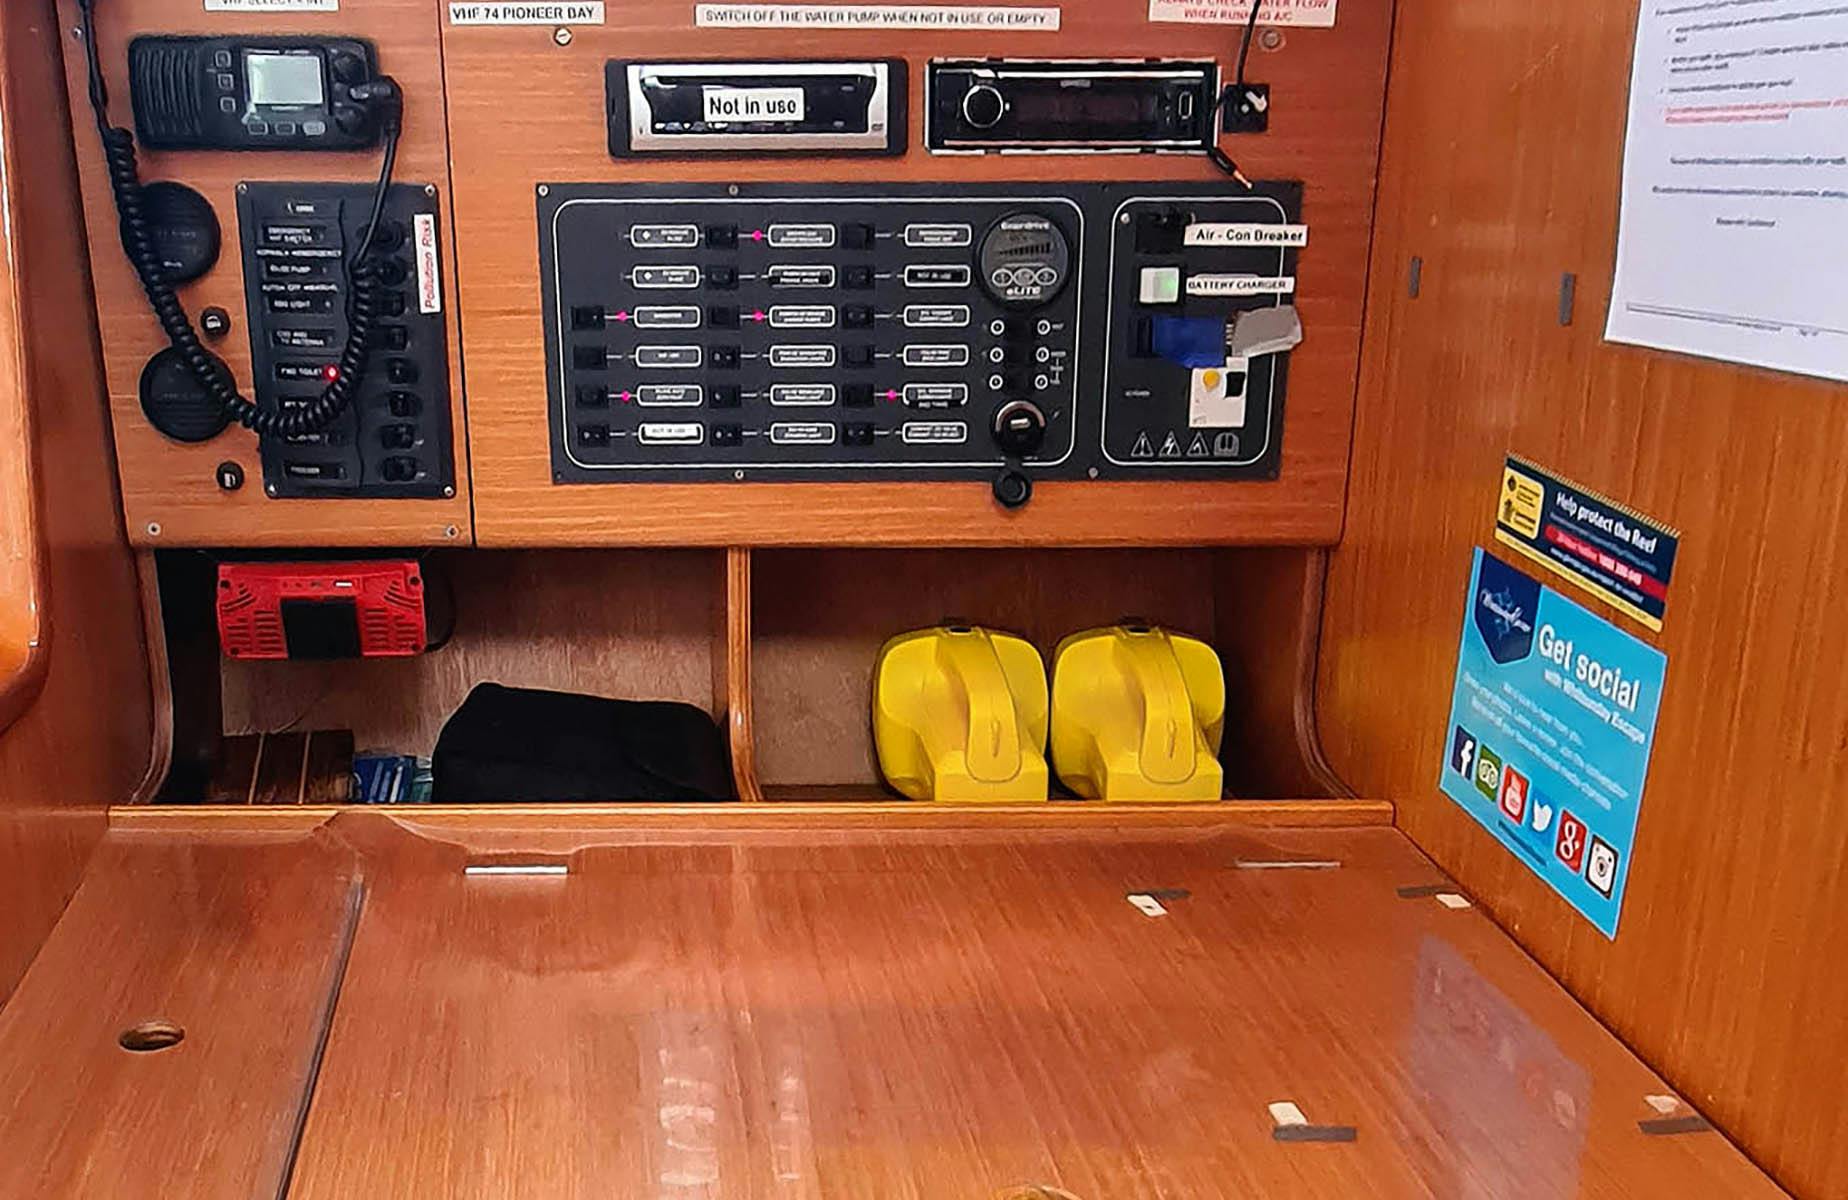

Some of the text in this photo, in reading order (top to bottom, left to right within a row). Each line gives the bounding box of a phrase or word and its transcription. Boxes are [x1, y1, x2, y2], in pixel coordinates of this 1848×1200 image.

[453, 6, 479, 19] VHF
[484, 6, 499, 19] 74
[503, 6, 564, 19] PIONEER
[706, 9, 1046, 24] SWITCH OFF THE WATER PUMP WHEN NOT IN USE OR EMPTY
[709, 95, 796, 115] Not in use
[1196, 228, 1215, 241] Air
[1226, 228, 1250, 241] Con
[1254, 229, 1303, 242] Breaker
[421, 218, 436, 309] Pollution Risk
[1188, 280, 1286, 290] BATTERY CHARGER
[1556, 491, 1578, 517] Help
[1577, 504, 1614, 534] protect
[1614, 520, 1631, 543] the
[1632, 528, 1658, 555] Reef
[1538, 623, 1641, 713] Get social
